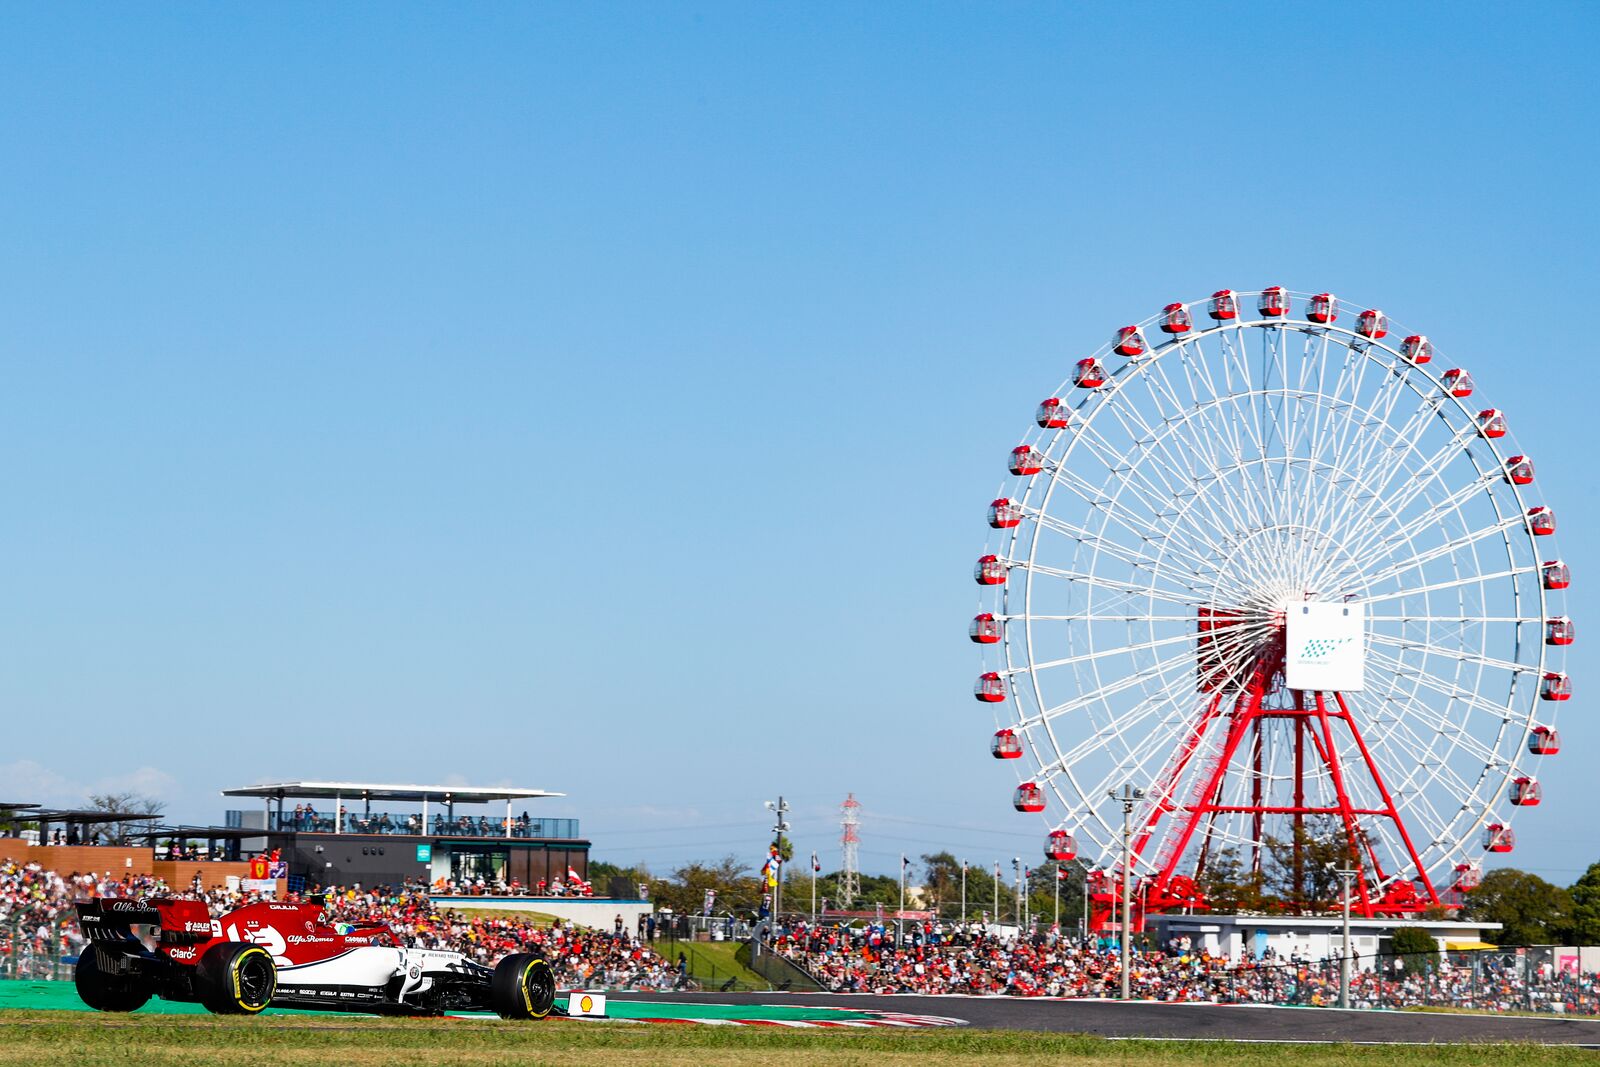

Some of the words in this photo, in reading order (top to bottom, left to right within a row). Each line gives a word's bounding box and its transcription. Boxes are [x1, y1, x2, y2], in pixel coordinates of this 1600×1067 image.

[113, 901, 137, 912] Alfa
[137, 897, 159, 912] Rom
[287, 934, 305, 945] Alfa
[305, 935, 334, 943] Romeo
[170, 947, 194, 960] Claro
